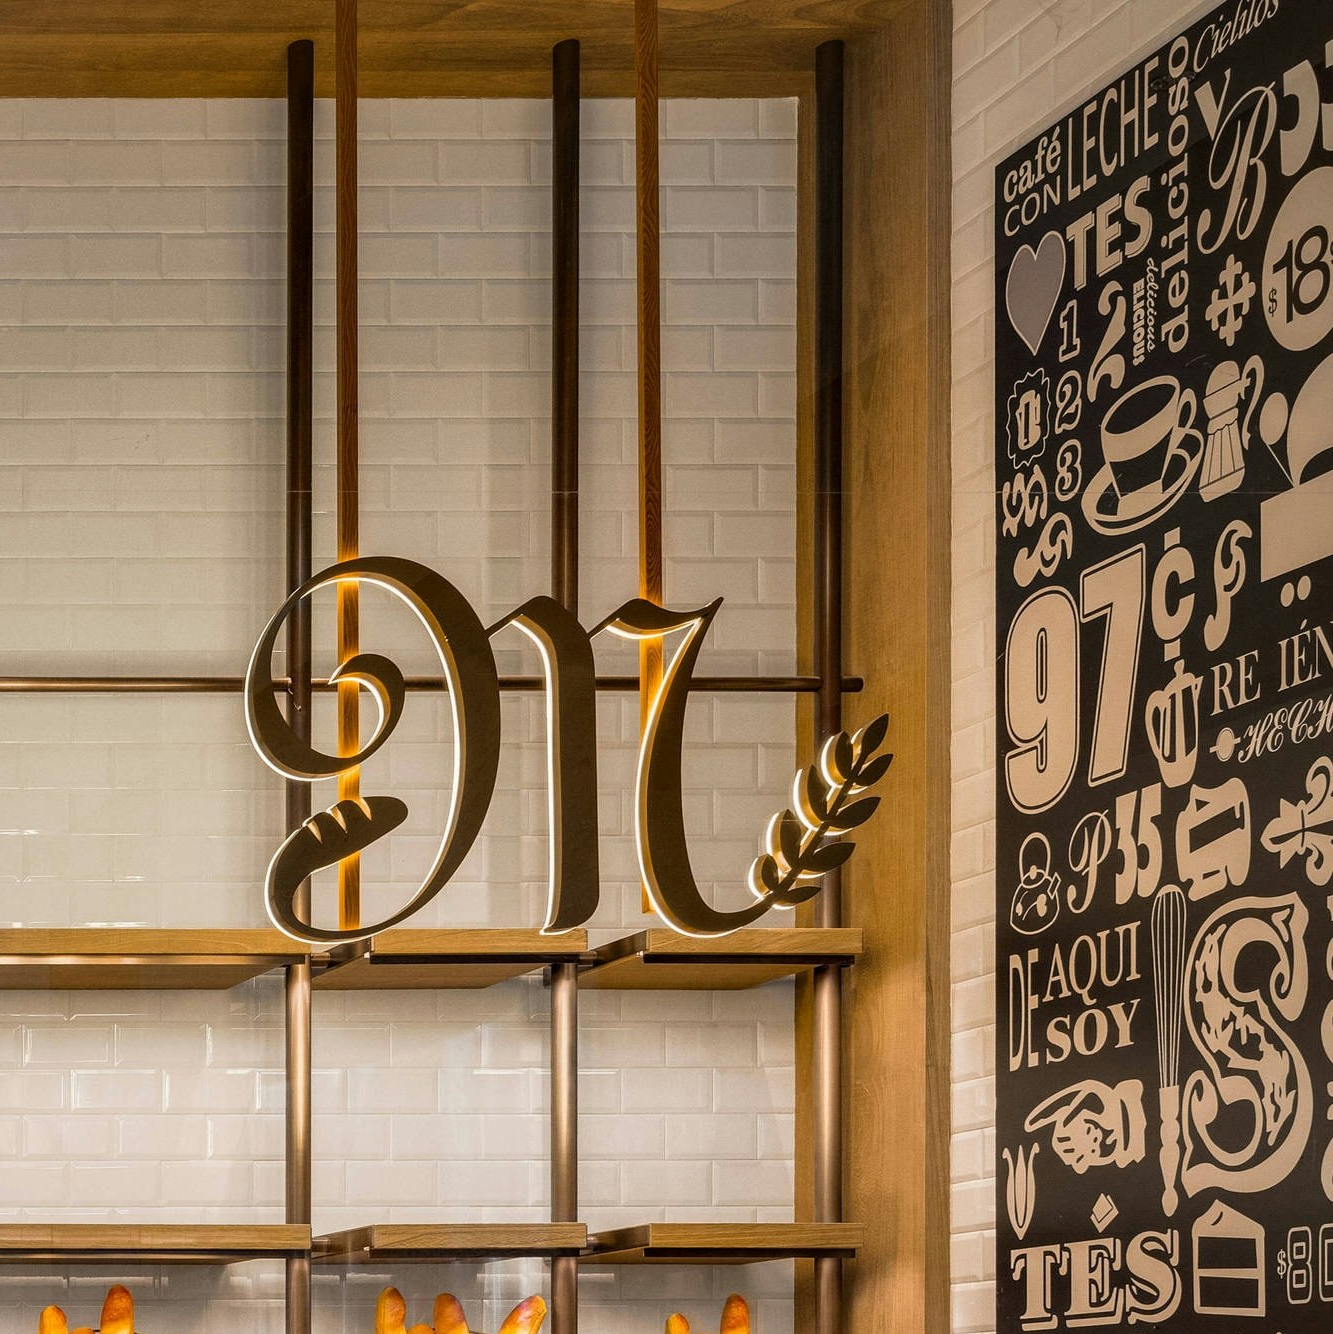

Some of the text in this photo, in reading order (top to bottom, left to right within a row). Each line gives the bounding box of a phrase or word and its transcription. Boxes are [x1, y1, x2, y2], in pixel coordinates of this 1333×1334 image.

[1003, 125, 1062, 204] café
[1068, 56, 1159, 201] LECHE
[1004, 175, 1061, 237] CON
[1066, 175, 1154, 291] TES
[1161, 36, 1189, 354] delicioso
[1042, 920, 1141, 1006] AQUI
[1045, 998, 1141, 1065] SOY
